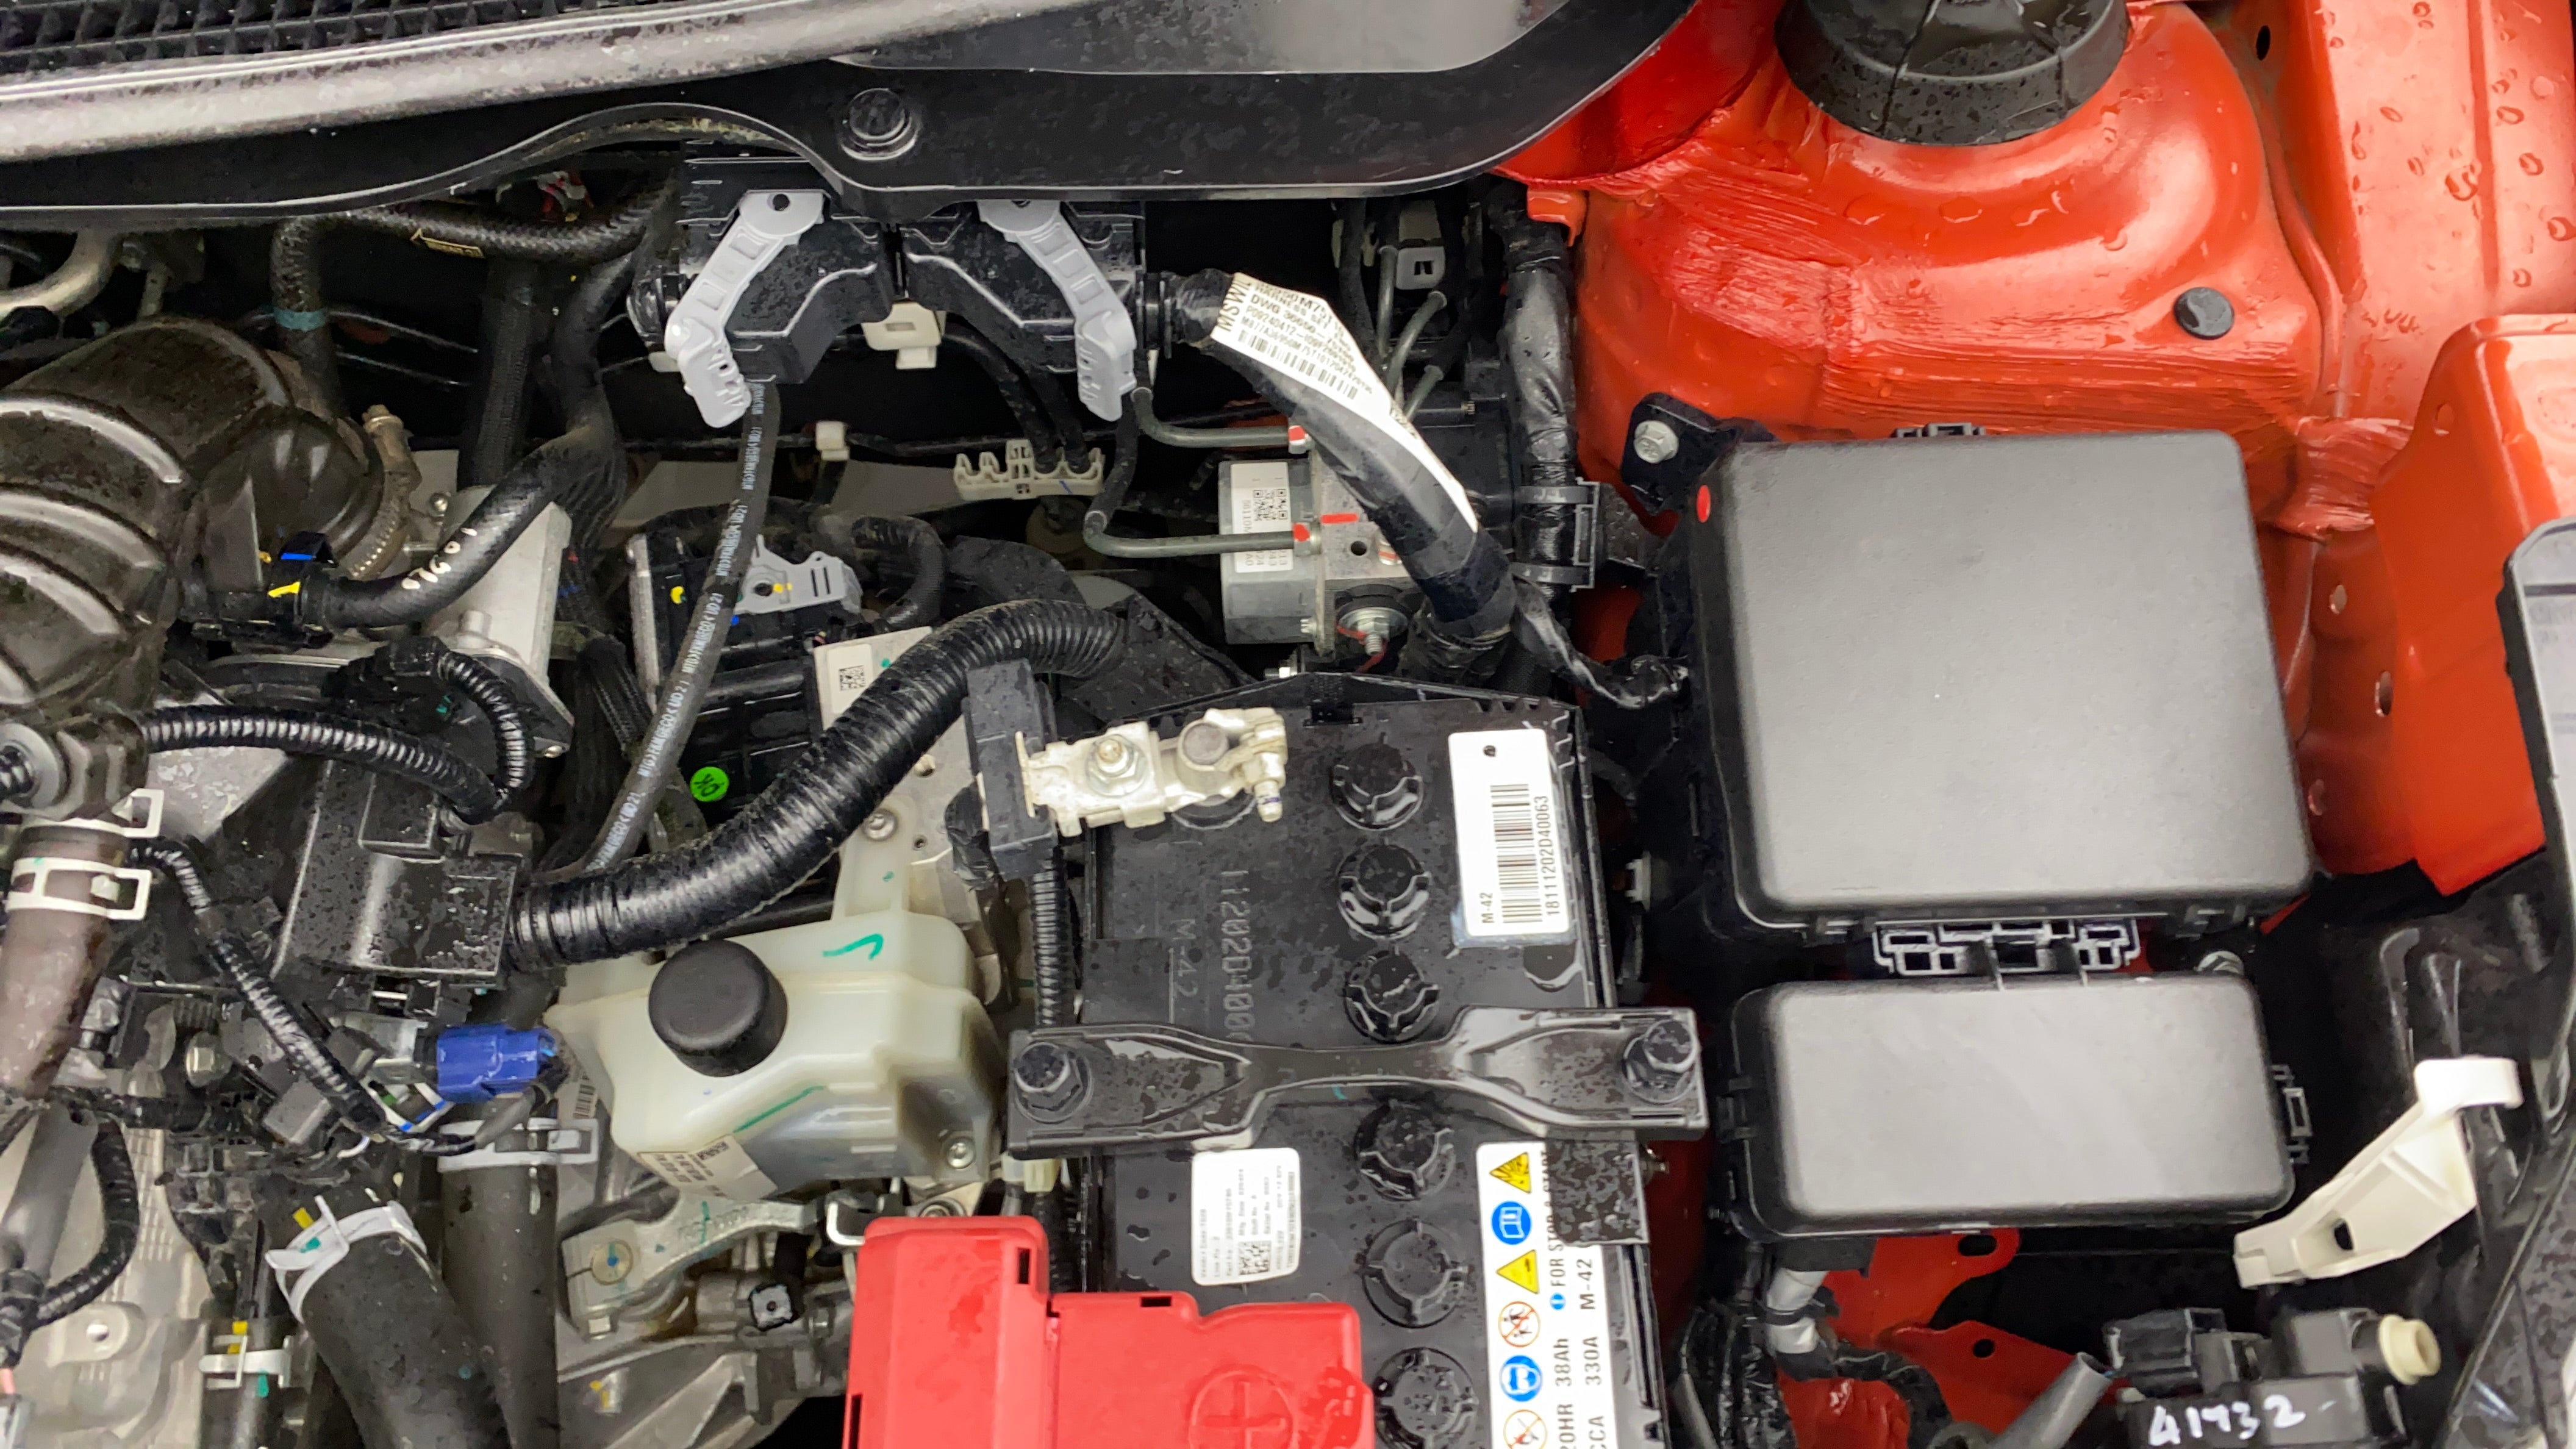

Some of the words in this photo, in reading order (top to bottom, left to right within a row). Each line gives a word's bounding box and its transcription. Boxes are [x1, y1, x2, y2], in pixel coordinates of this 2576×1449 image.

[1220, 281, 1251, 332] MSWIL
[1251, 295, 1279, 313] DWG
[1534, 795, 1560, 916] 18111202D40063
[1480, 892, 1494, 923] M-42
[1551, 1259, 1565, 1287] FOR
[1576, 1259, 1595, 1309] M-42
[1553, 1338, 1572, 1386] 38Ah
[1583, 1337, 1601, 1385] 330A
[1558, 1404, 1577, 1449] 0HR
[1589, 1416, 1606, 1449] CA
